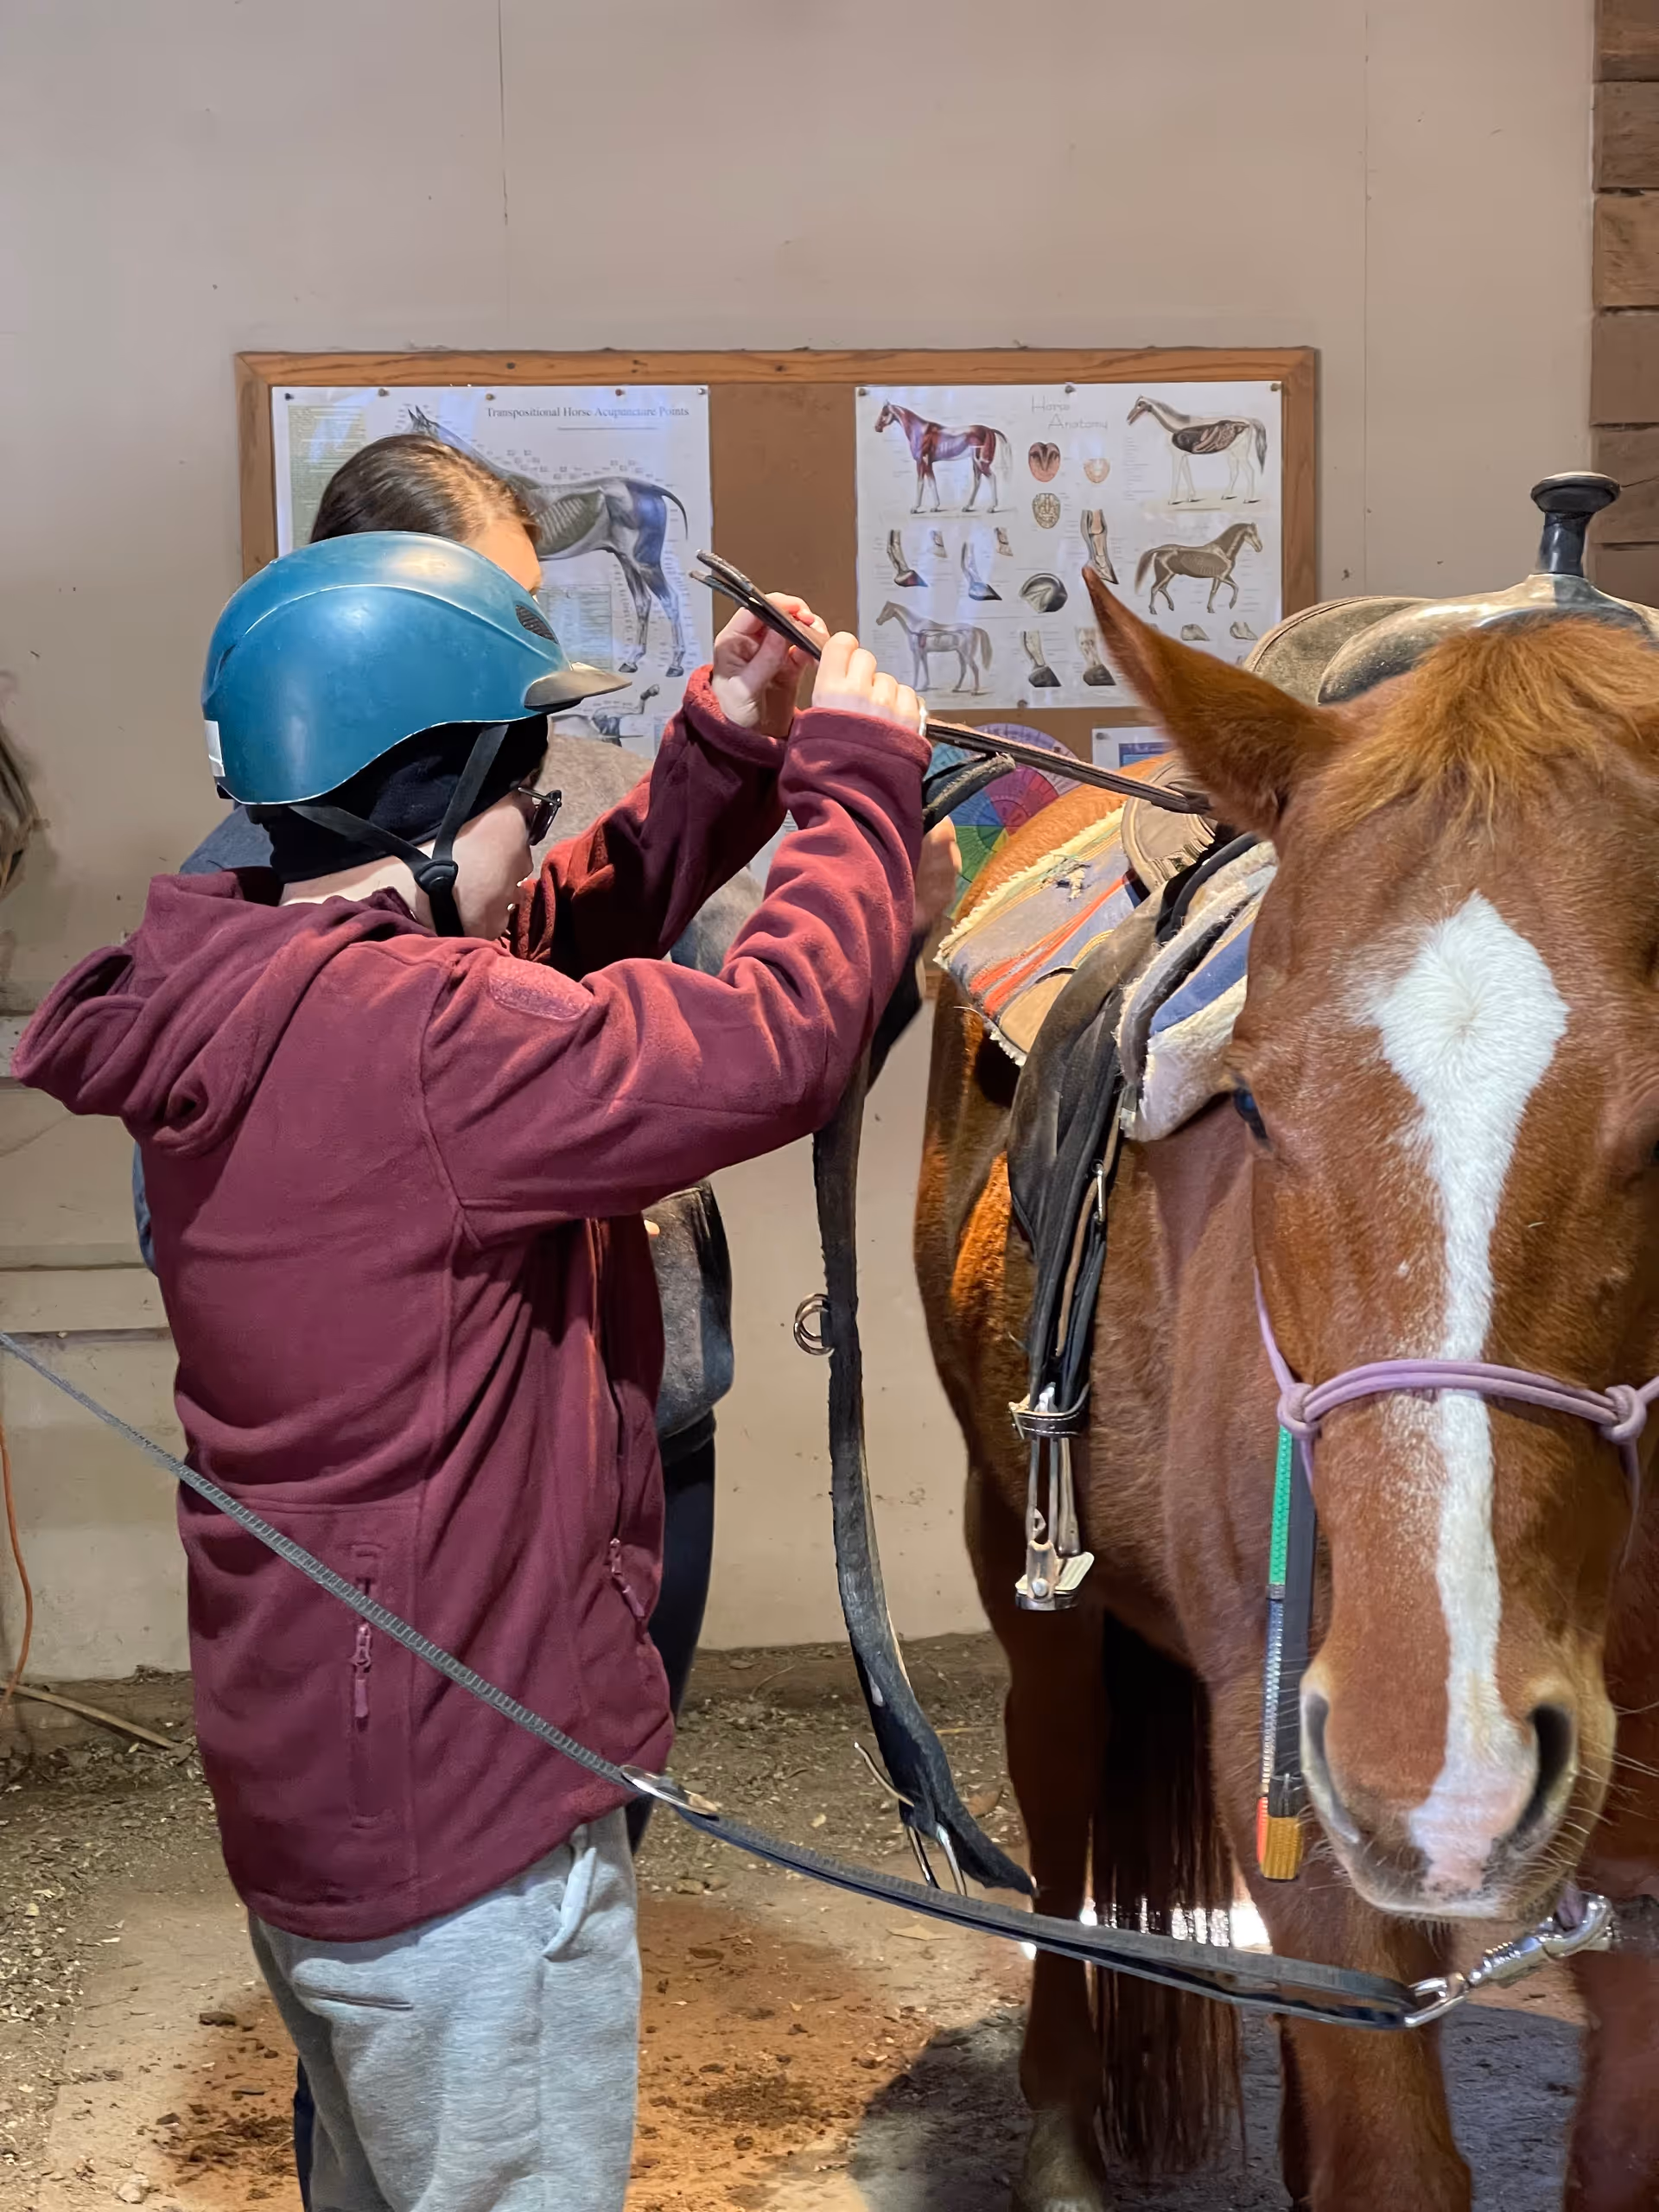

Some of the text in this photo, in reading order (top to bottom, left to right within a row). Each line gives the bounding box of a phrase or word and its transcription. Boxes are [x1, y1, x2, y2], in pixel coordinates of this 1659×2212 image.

[486, 405, 690, 420] Transpositional Horse Acupuncture Points
[1031, 395, 1071, 413] Horse
[1048, 413, 1109, 431] Anatomy
